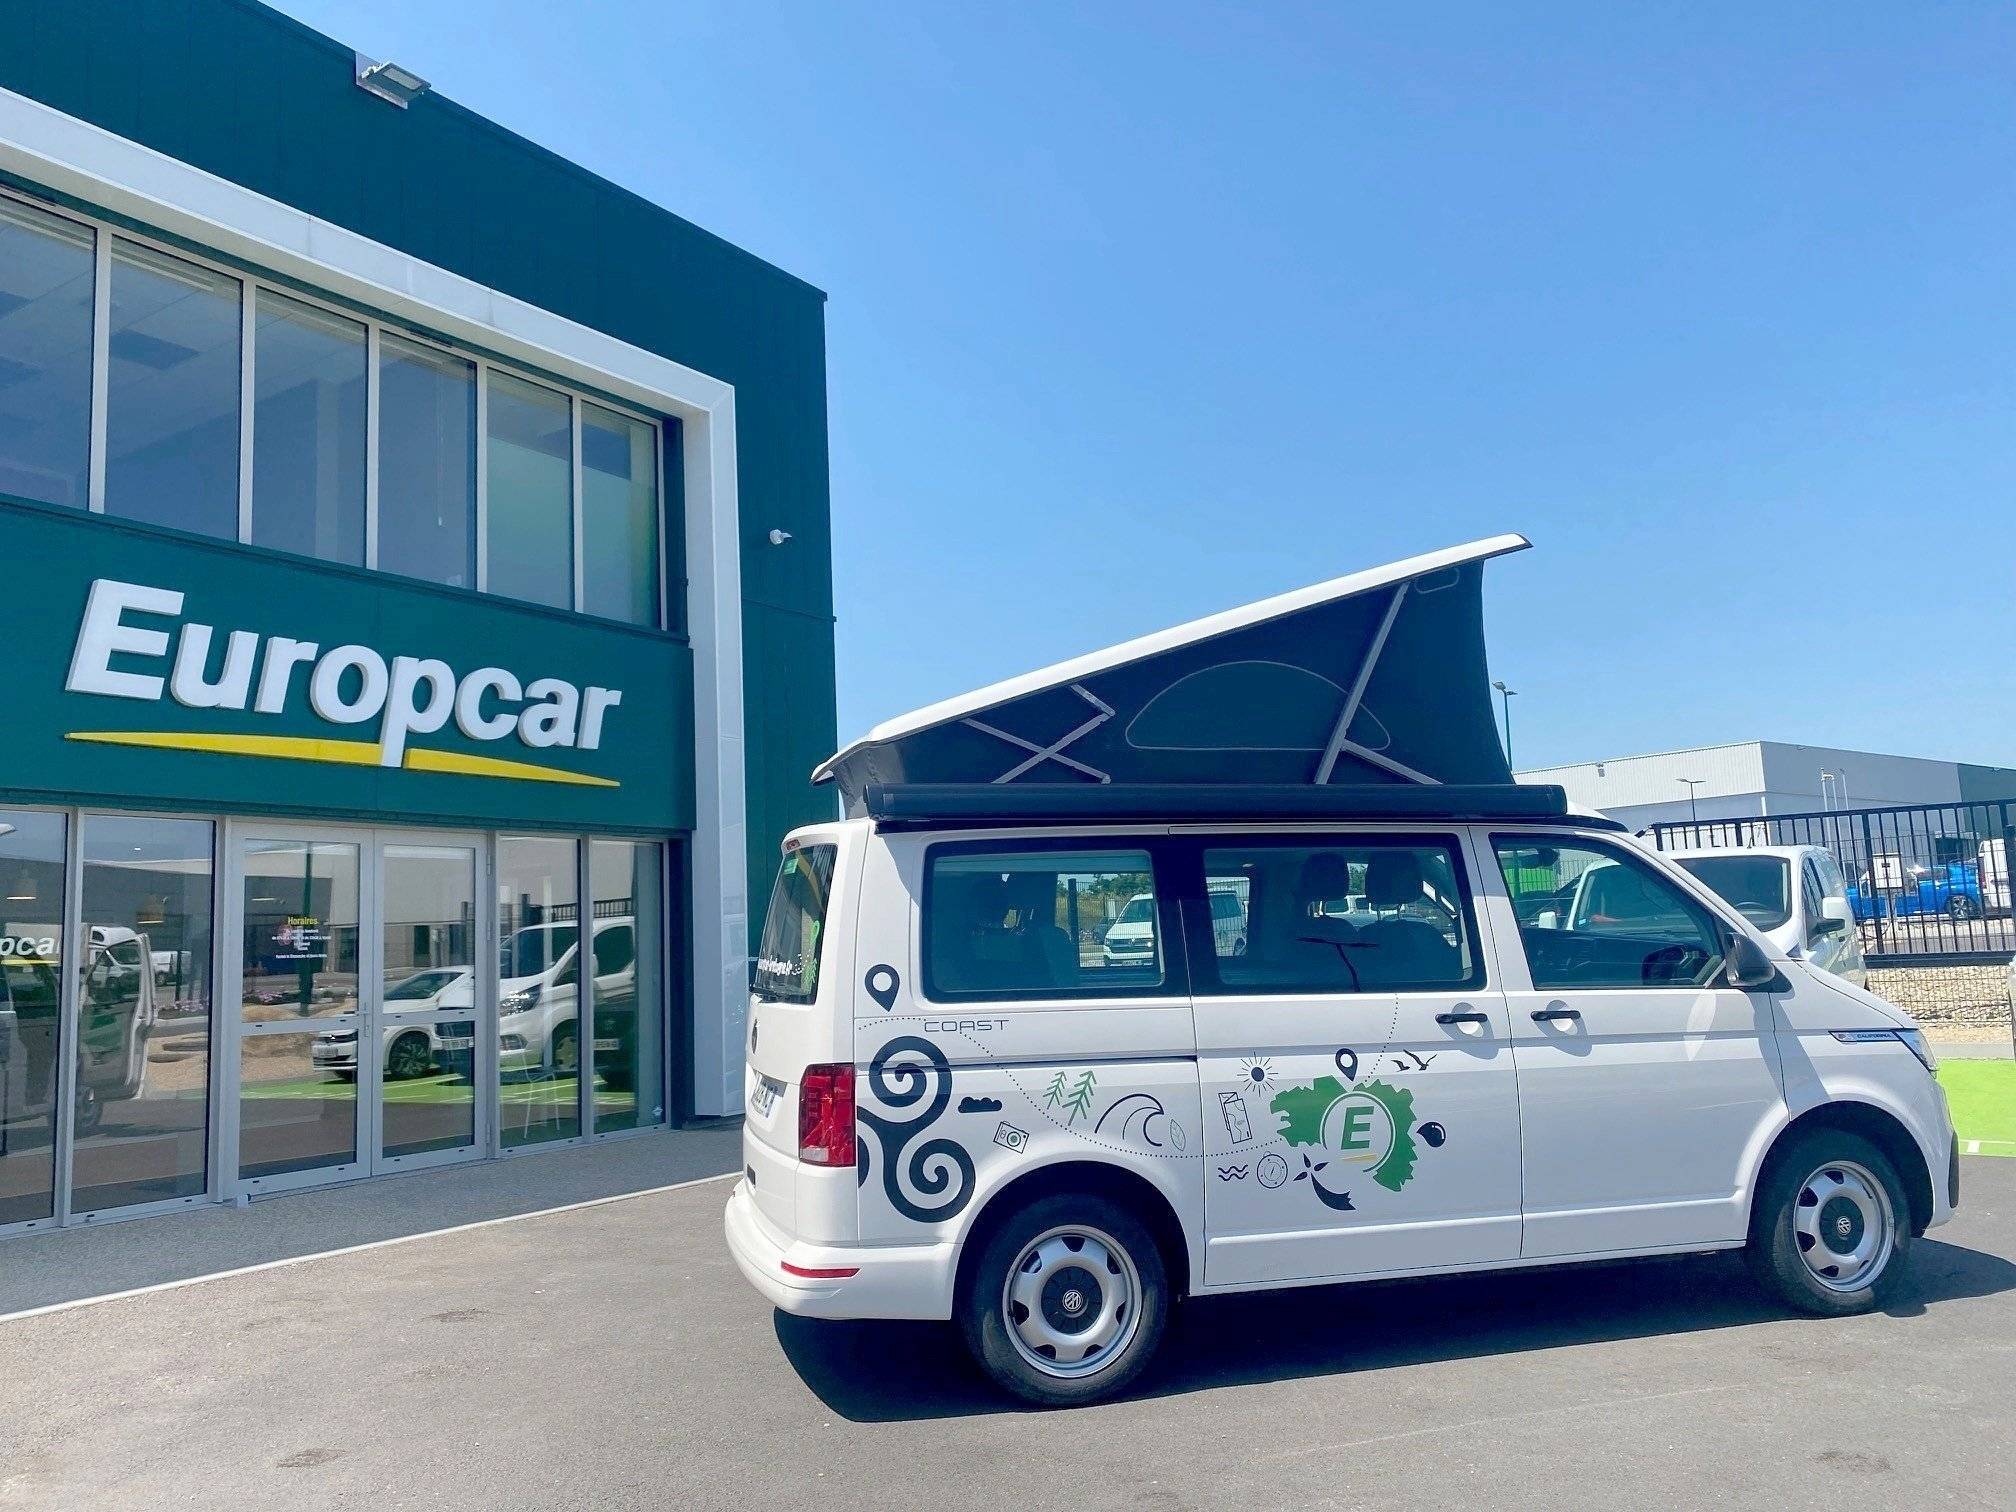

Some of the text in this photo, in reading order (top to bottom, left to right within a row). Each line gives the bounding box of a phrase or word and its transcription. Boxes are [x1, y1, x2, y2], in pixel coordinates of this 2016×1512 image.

[65, 578, 622, 768] Europcar
[288, 917, 318, 925] Horaires
[925, 1020, 1009, 1032] COAST
[1341, 1106, 1374, 1150] E
